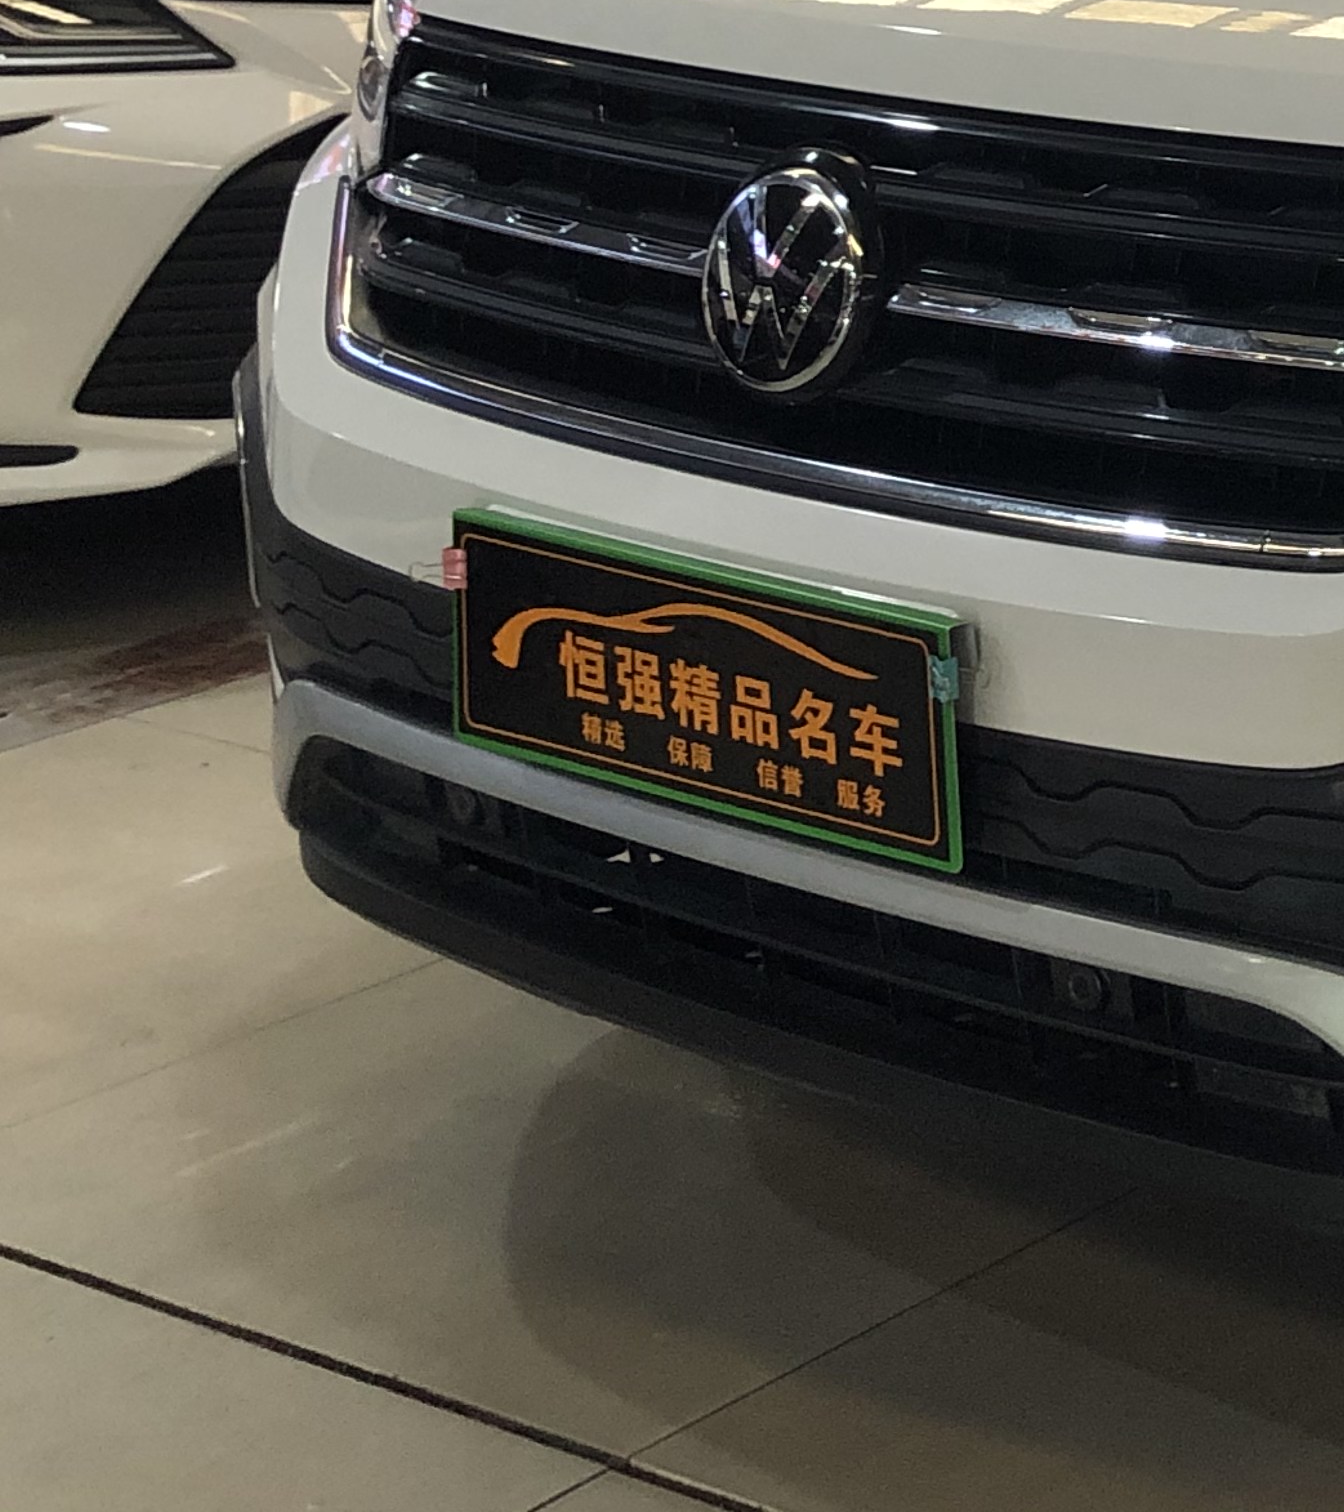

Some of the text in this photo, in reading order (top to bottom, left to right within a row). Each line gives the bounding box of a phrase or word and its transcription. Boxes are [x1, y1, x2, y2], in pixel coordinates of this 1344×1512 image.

[559, 629, 903, 777] 恒强精品名车
[580, 712, 886, 818] 精选 保障 信誉 服务
